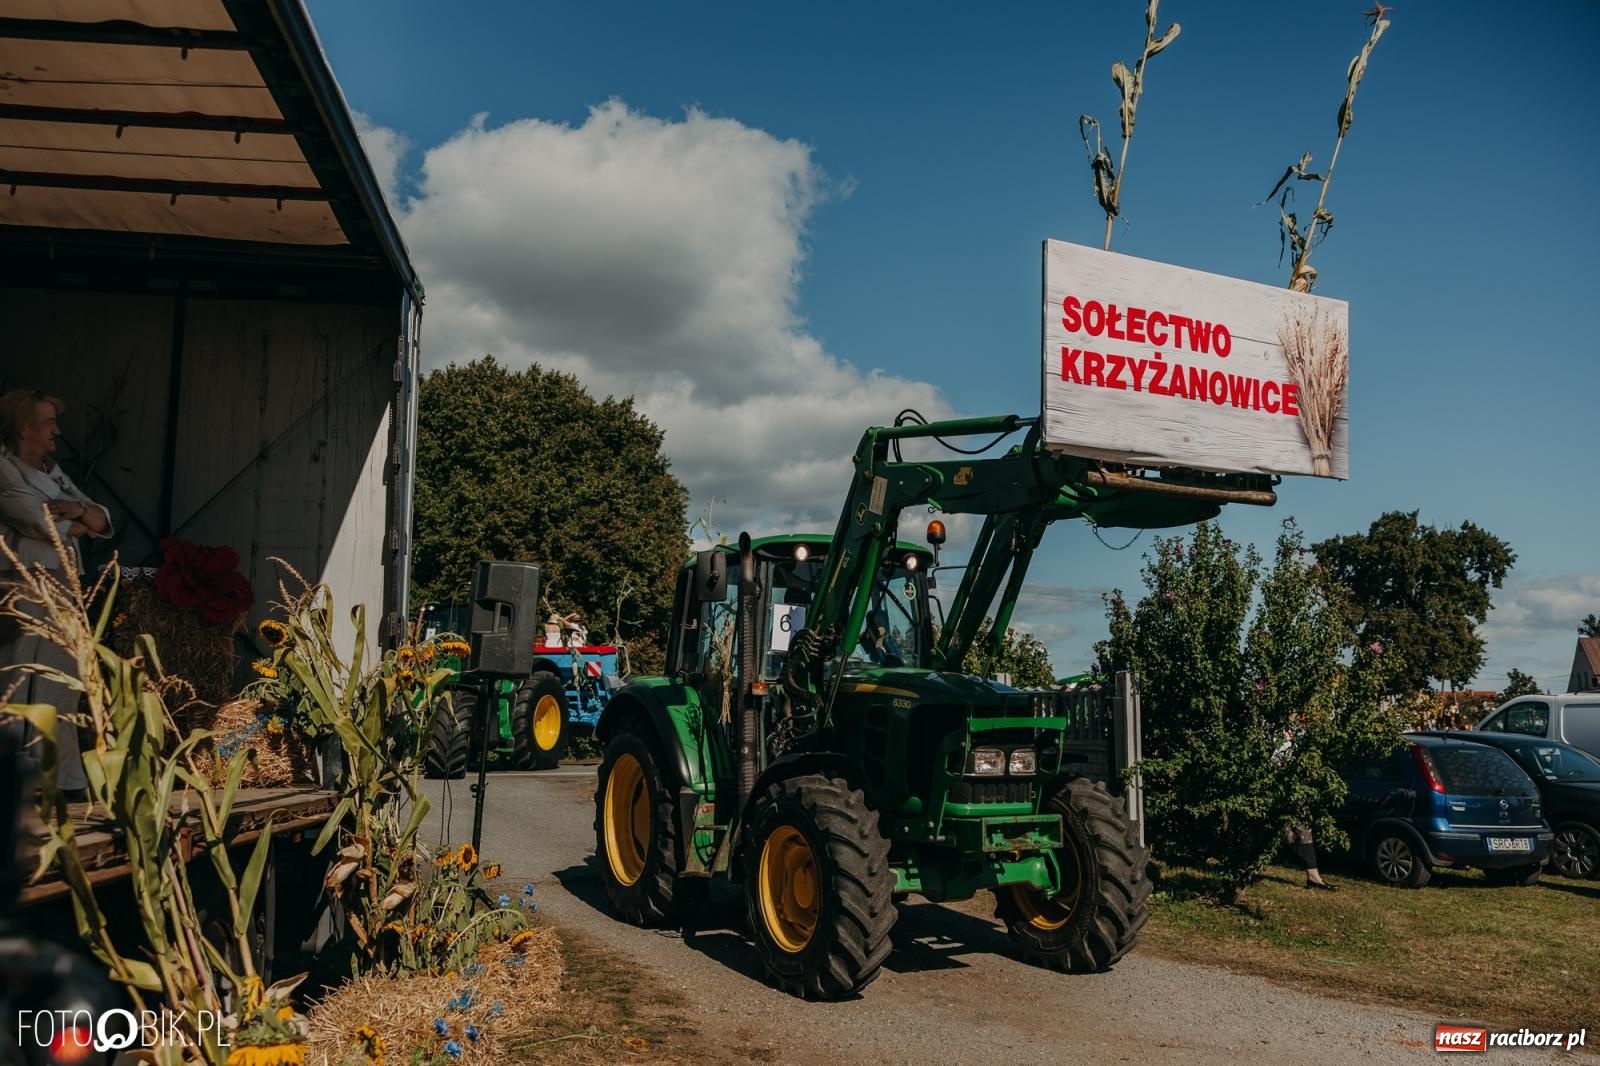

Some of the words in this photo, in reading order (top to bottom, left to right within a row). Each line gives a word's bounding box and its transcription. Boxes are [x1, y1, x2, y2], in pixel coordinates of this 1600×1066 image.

[1061, 295, 1232, 358] SOŁECTWO
[1061, 347, 1299, 417] KRZYŻANOWICE
[780, 614, 792, 633] 6
